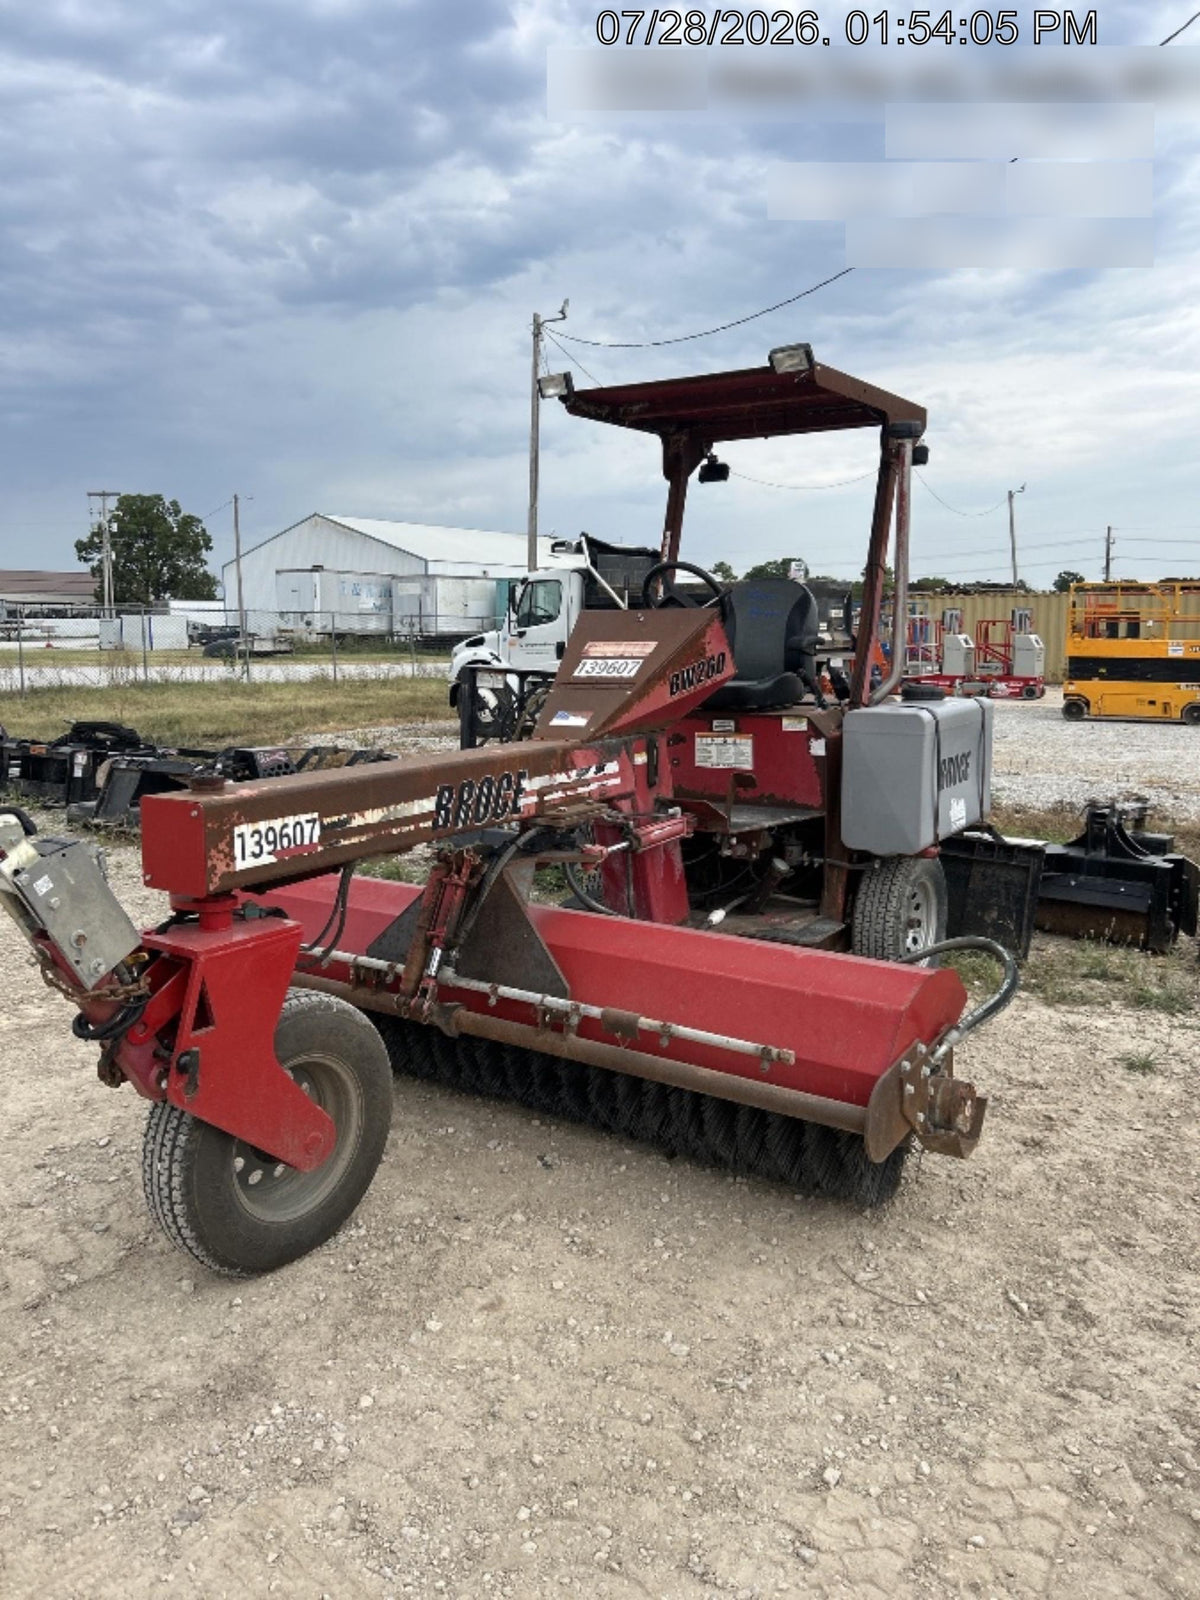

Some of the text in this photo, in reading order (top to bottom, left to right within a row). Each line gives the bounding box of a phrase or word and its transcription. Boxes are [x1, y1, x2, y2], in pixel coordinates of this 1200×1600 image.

[577, 660, 641, 675] 139607
[669, 652, 726, 697] BW260
[236, 817, 318, 861] 139607
